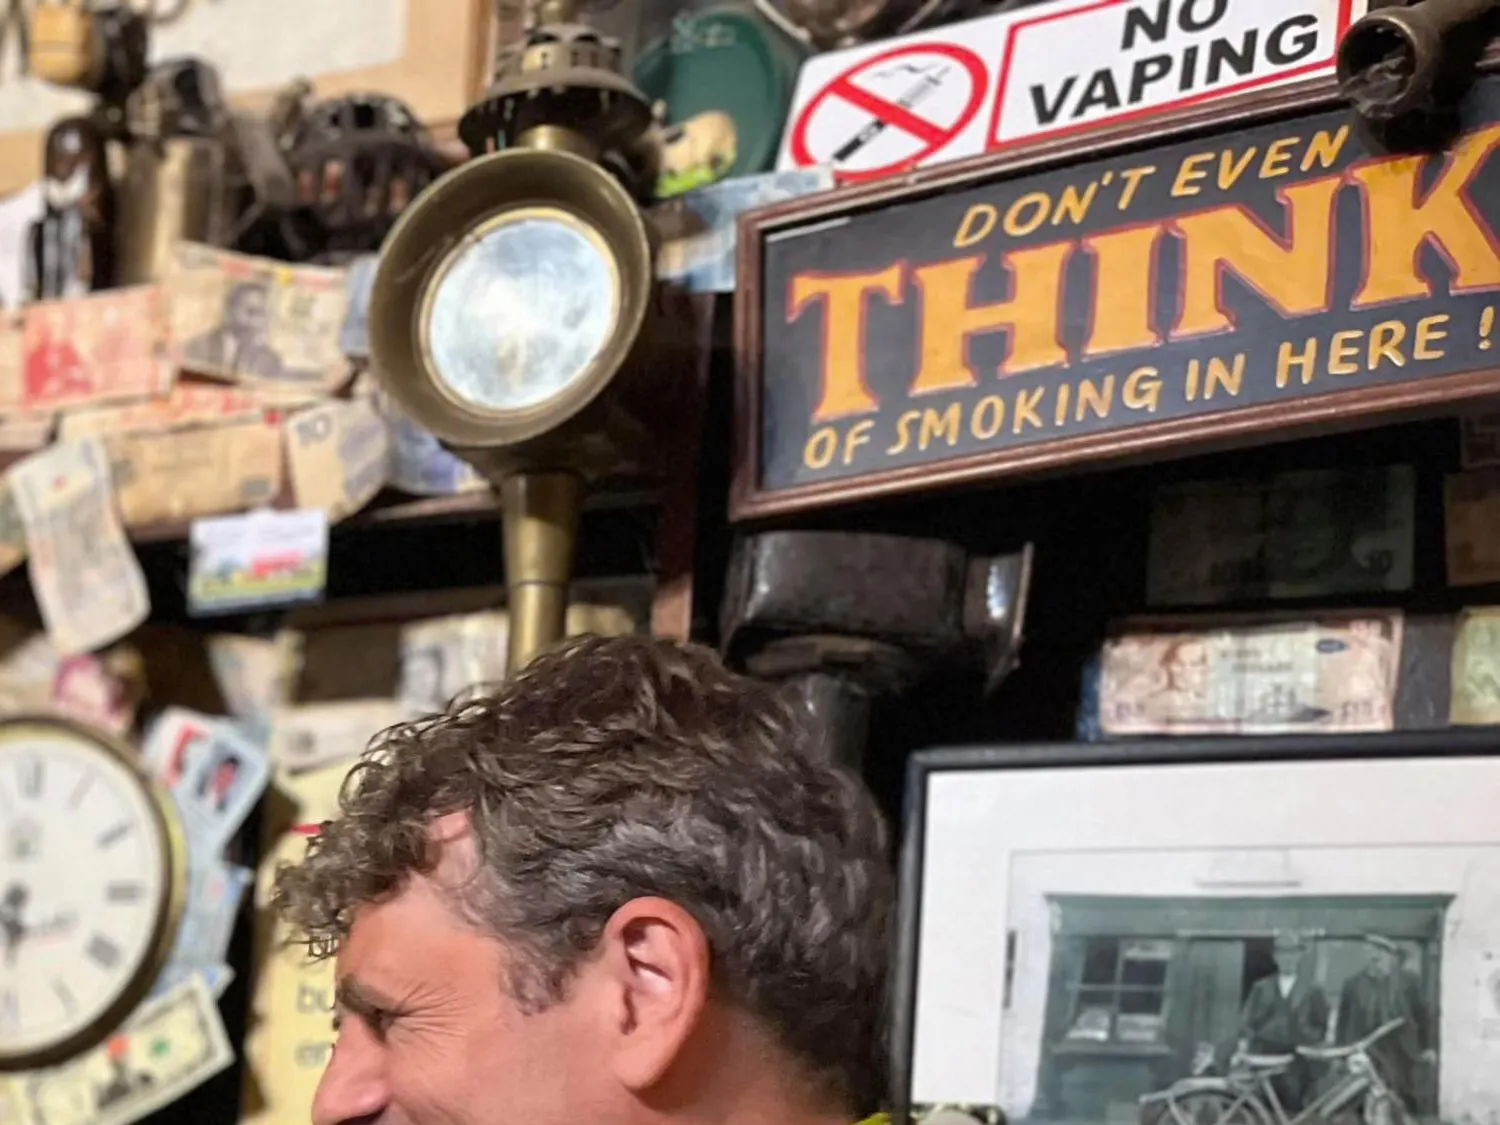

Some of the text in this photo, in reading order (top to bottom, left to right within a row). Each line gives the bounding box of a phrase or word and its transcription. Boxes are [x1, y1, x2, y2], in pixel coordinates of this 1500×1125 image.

[1029, 14, 1318, 126] VAPING
[1121, 0, 1228, 51] NO
[953, 125, 1350, 248] DON'T EVEN
[786, 122, 1500, 424] THINK
[803, 420, 874, 470] OF
[886, 366, 1163, 456] SMOKING
[1186, 353, 1244, 402] IN
[1275, 314, 1450, 389] HERE
